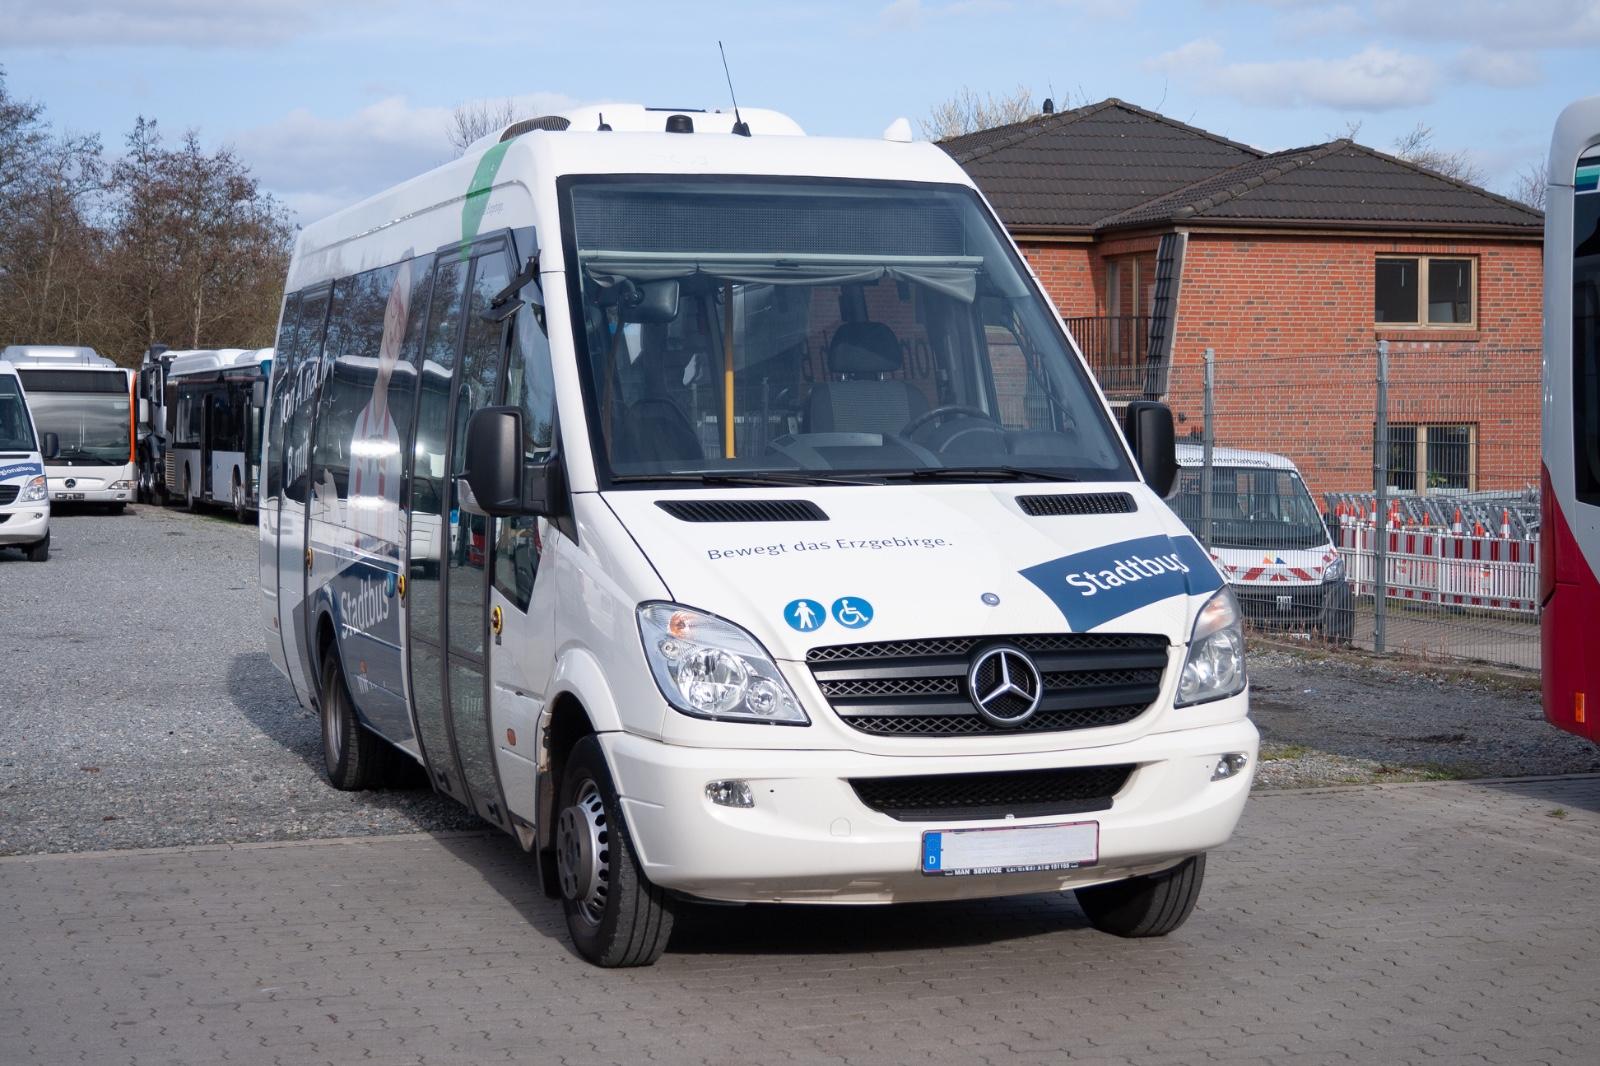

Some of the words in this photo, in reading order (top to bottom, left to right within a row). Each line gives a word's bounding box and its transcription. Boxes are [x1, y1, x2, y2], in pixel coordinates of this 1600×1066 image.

[708, 543, 788, 560] Bewegt
[794, 540, 831, 552] das
[836, 536, 953, 550] Erzgebirge.
[1065, 552, 1190, 596] Stadtbus
[341, 573, 390, 640] Stadtbus
[928, 855, 936, 865] D
[954, 868, 971, 876] MAN
[973, 866, 1003, 876] SERVICE
